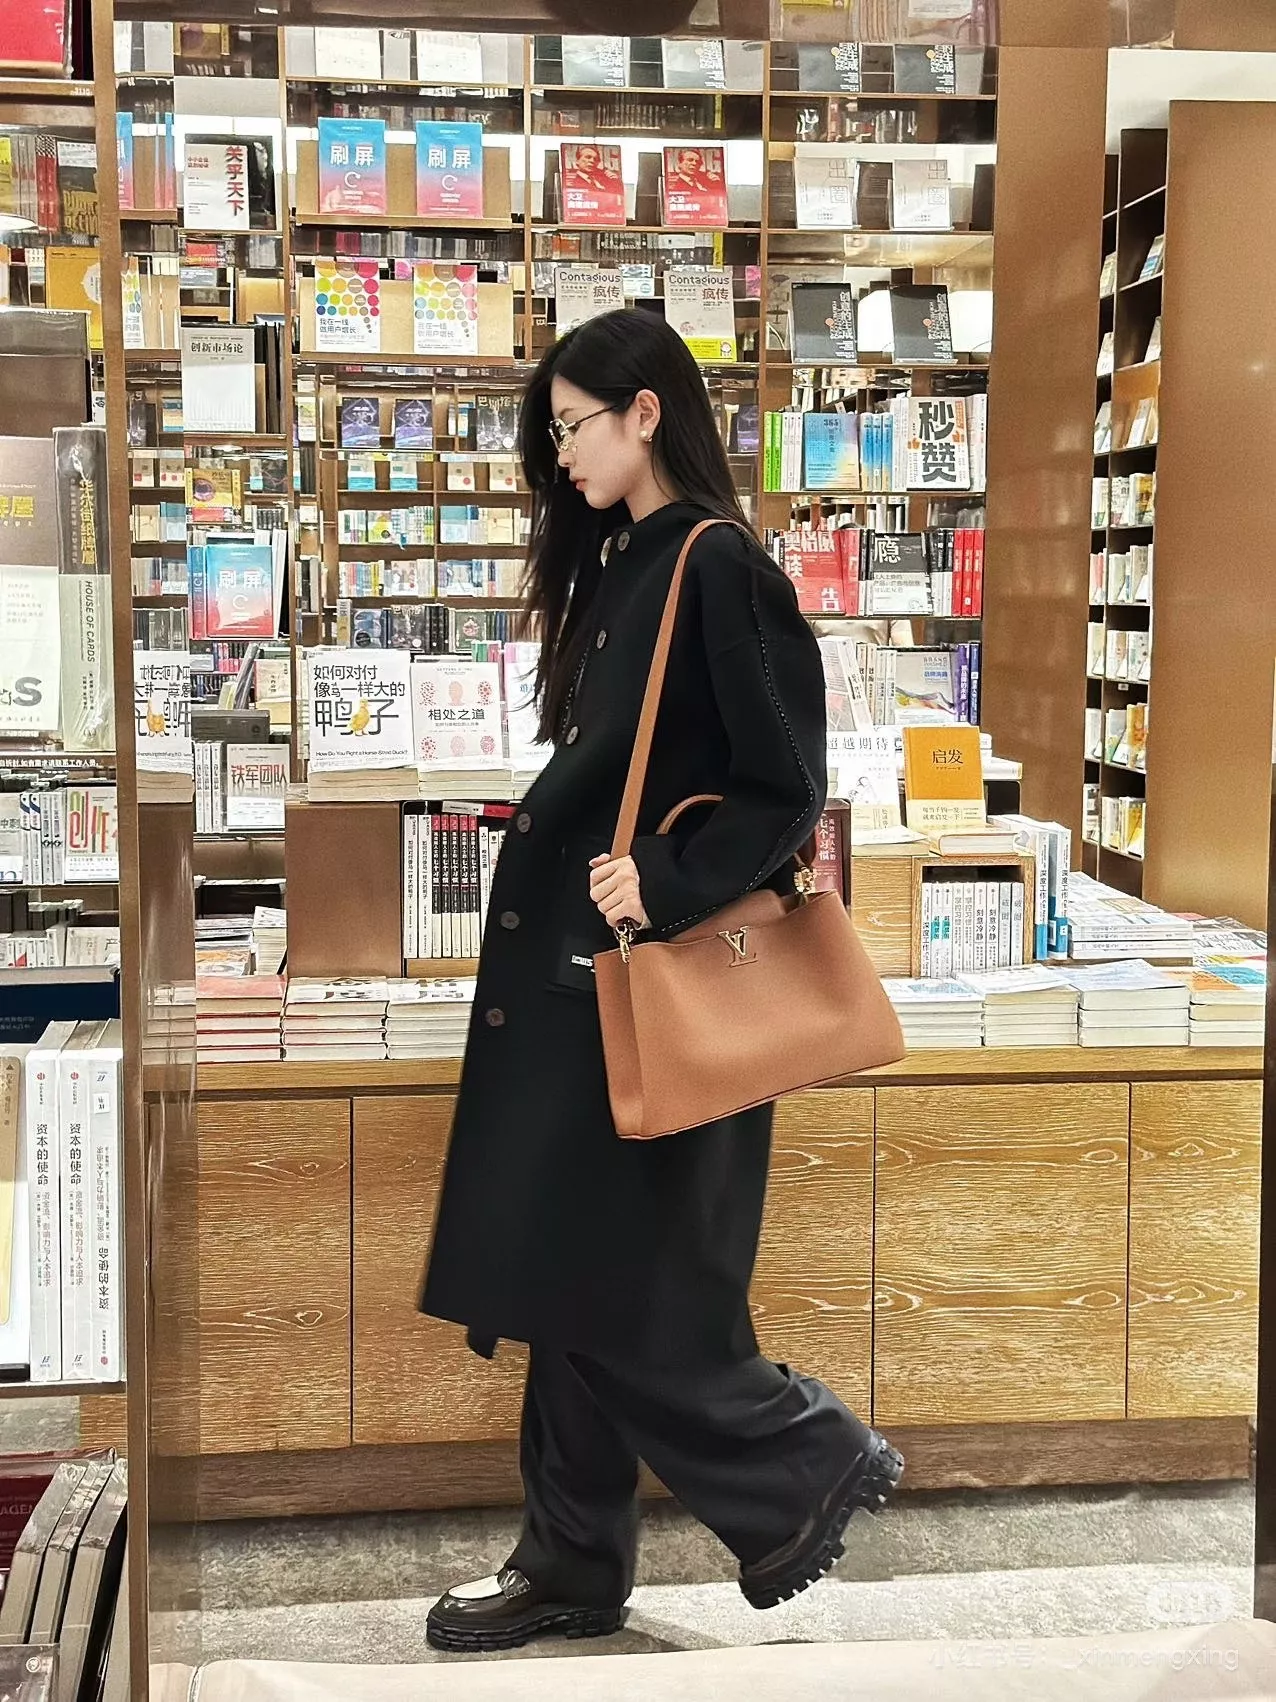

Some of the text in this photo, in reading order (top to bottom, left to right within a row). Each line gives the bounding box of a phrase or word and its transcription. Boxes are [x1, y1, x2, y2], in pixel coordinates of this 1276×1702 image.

[330, 144, 375, 167] 刷屏
[428, 147, 472, 169] 刷屏
[226, 146, 245, 216] 关乎天下
[559, 271, 621, 286] Contagious
[669, 274, 730, 286] Contagious
[593, 286, 620, 298] 疯传
[702, 288, 729, 300] 疯传
[191, 342, 244, 354] 创新市场论
[918, 400, 957, 483] 秒赞
[784, 531, 836, 553] 奥格威
[874, 535, 901, 564] 瘾
[219, 569, 263, 589] 刷屏
[85, 580, 94, 615] HOUSE
[86, 617, 94, 629] OF
[87, 630, 95, 662] CARDS
[314, 664, 378, 681] 如何对付
[314, 681, 406, 698] 像马一样大的
[314, 697, 399, 737] 鸭子
[428, 708, 485, 720] 相处之道
[932, 749, 964, 765] 启发
[231, 764, 287, 786] 铁军团队
[36, 1123, 48, 1186] 资本的使命
[69, 1123, 81, 1186] 资本的使命
[98, 1247, 109, 1310] 资本的使命
